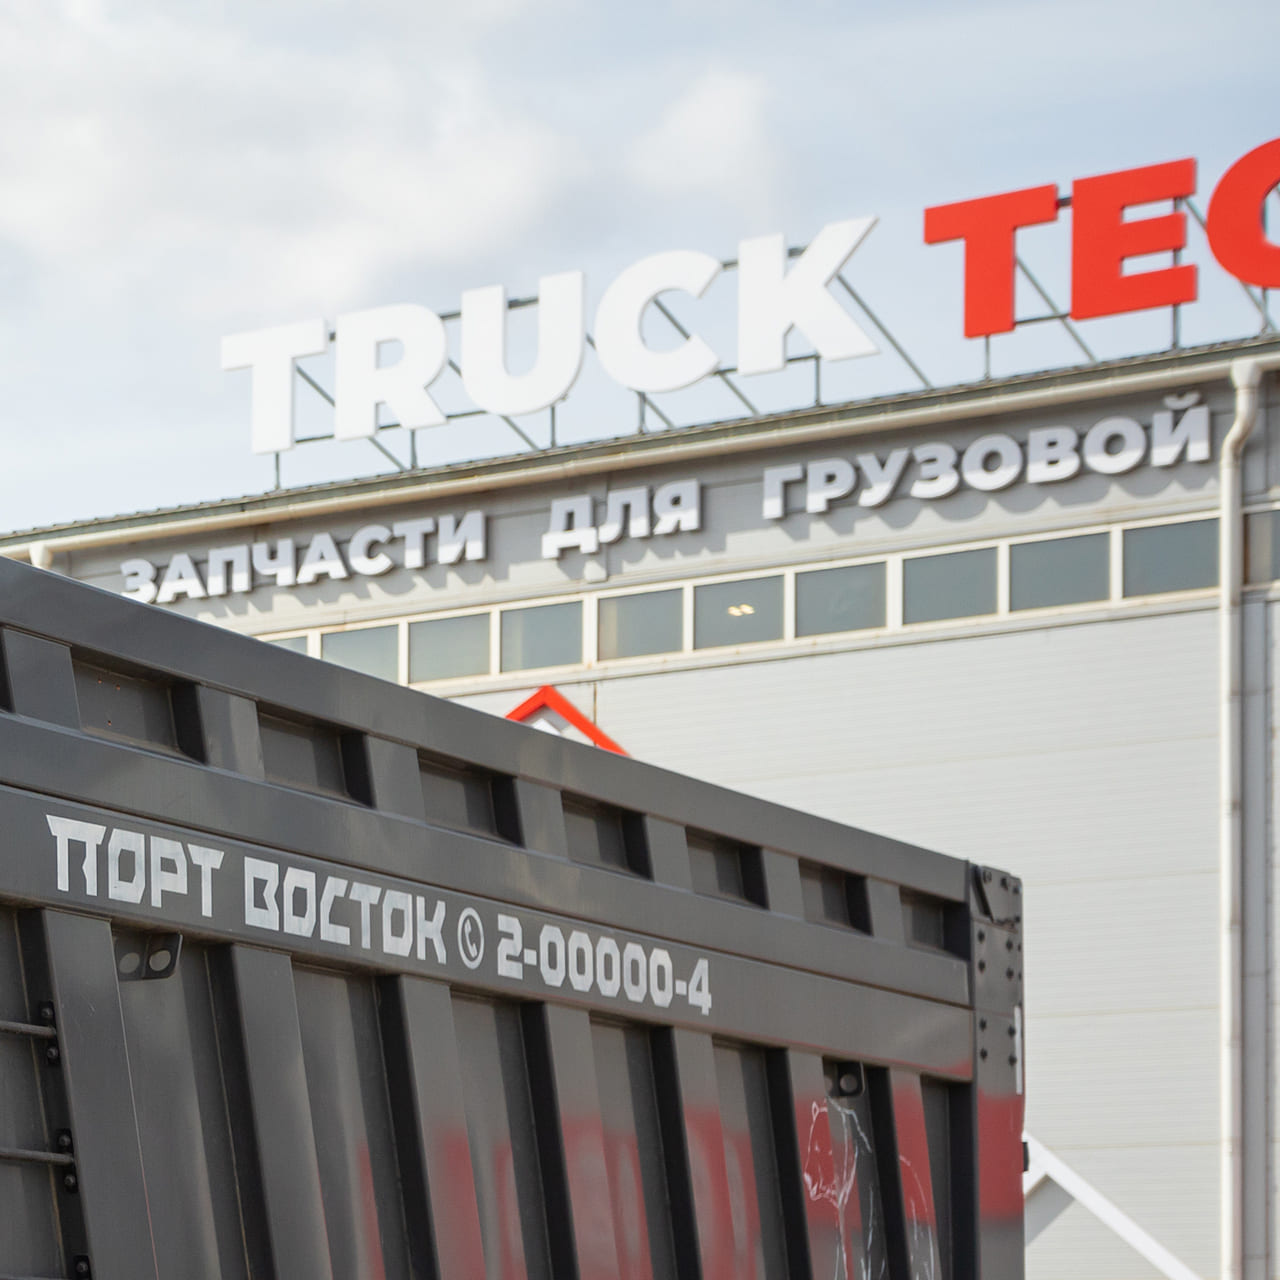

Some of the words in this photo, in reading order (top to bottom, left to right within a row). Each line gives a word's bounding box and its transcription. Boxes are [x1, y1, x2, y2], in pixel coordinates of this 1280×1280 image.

[221, 215, 879, 455] TRUCK
[120, 510, 487, 604] ЗАПЧАСТИ
[541, 479, 702, 560] ДЛЯ
[762, 392, 1212, 519] ГРУЗОВОЙ
[45, 814, 225, 918] ПОРТ
[244, 856, 447, 964] ВОСТОК
[497, 913, 712, 1016] 2-00000-4
